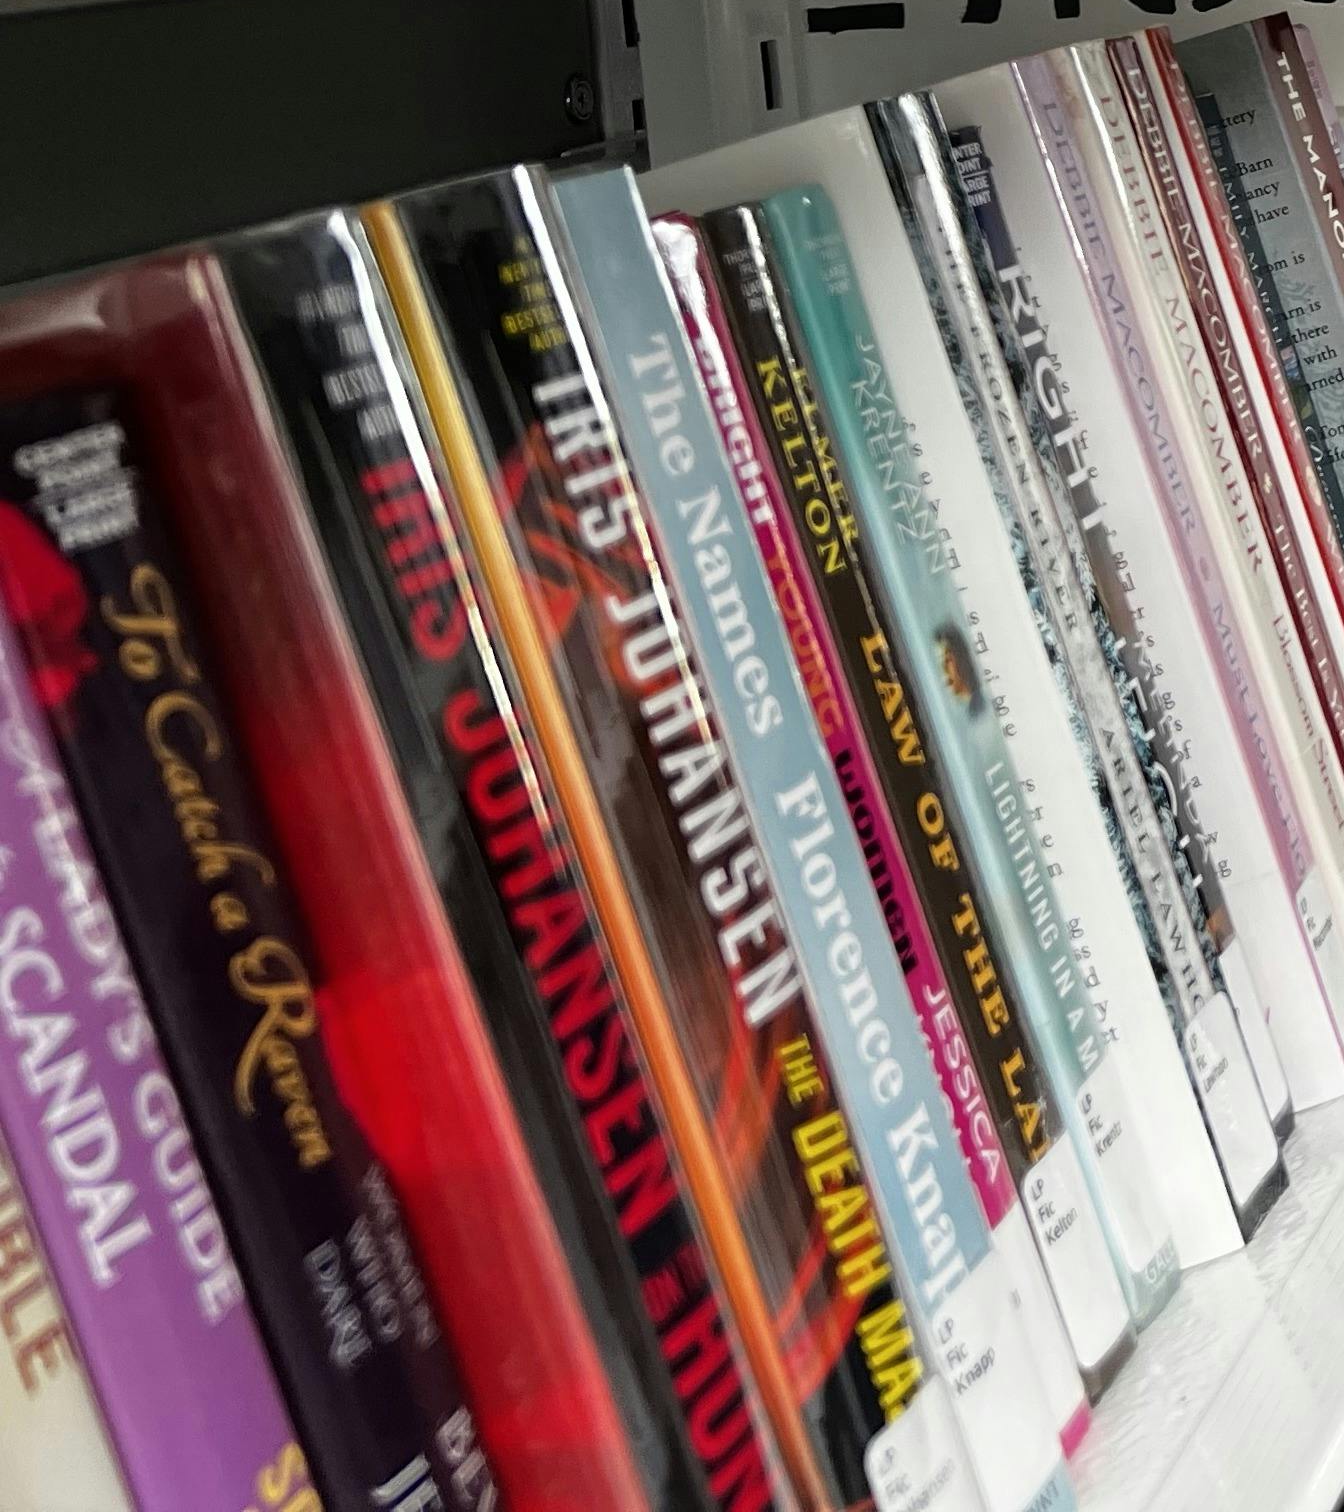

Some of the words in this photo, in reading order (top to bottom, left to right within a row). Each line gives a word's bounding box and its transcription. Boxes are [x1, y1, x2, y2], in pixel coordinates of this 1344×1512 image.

[1237, 157, 1273, 178] Barn
[1276, 50, 1307, 122] THE
[1125, 63, 1182, 217] DEBBIE
[1177, 220, 1265, 460] MACOMBER
[1255, 204, 1290, 226] have
[1043, 101, 1105, 263] DEBBIE
[1099, 272, 1198, 540] MACOMBER
[1099, 94, 1171, 281] DEBBIE
[1165, 294, 1266, 578] MACOMBER
[1220, 211, 1304, 448] MACOMBER
[1291, 323, 1330, 345] there
[1303, 346, 1338, 367] with
[755, 354, 848, 577] KELTON
[851, 378, 922, 545] KRENTZ
[100, 564, 200, 682] To
[766, 542, 847, 739] YOUNG
[1026, 506, 1080, 636] RIVER
[143, 691, 277, 888] Catch
[533, 374, 630, 551] IRIS
[607, 590, 803, 1030] JOHANSEN
[628, 332, 696, 479] The
[679, 484, 784, 739] Names
[776, 769, 906, 1105] Florence
[361, 456, 469, 663] IRIS
[442, 689, 678, 1238] JOHANSEN
[859, 631, 927, 768] LAW
[914, 793, 961, 874] OF
[948, 891, 1010, 1040] THE
[1098, 728, 1149, 856] ARIEL
[208, 891, 250, 931] a
[982, 760, 1062, 951] LIGHTNING
[1052, 950, 1077, 998] IN
[1065, 1006, 1083, 1035] A
[227, 935, 332, 1168] Raven
[775, 1031, 828, 1107] THE
[922, 983, 1003, 1185] JESSICA
[130, 1072, 246, 1324] GUIDE
[790, 1112, 893, 1300] DEATH
[1028, 1177, 1046, 1201] LP
[1037, 1200, 1058, 1231] Fic
[1043, 1206, 1079, 1248] Kelton
[856, 1299, 927, 1425] MA
[954, 1344, 997, 1396] Knapp
